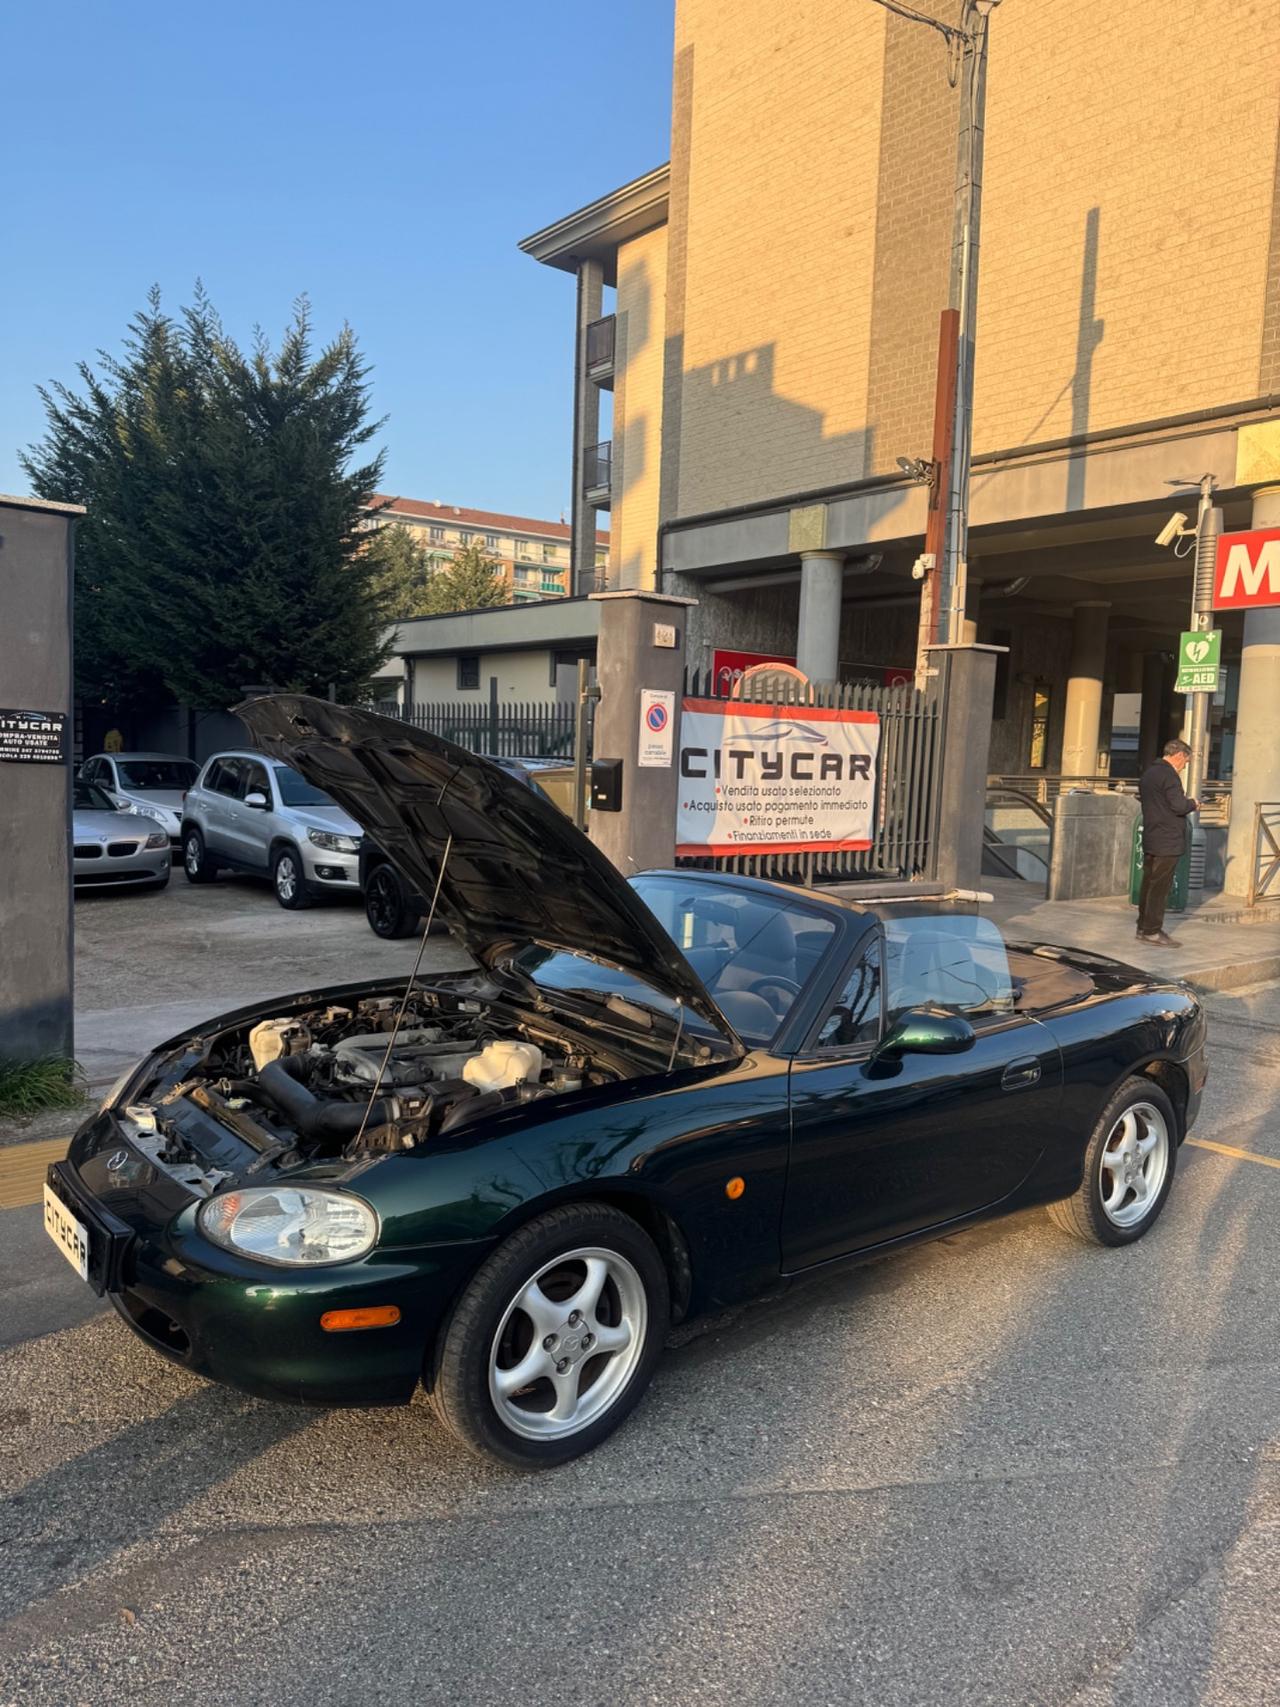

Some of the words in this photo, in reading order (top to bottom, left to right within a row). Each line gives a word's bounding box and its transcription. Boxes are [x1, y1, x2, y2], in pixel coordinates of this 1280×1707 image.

[1219, 540, 1280, 598] M
[1192, 673, 1215, 685] AED
[1, 720, 62, 731] ITYCAR
[0, 733, 58, 741] OMPRA-VENDITA
[680, 747, 871, 781] CITYCAR
[721, 785, 759, 797] Vendita
[761, 786, 788, 797] usato
[789, 785, 841, 797] selezionato
[689, 800, 733, 813] Acquisto
[735, 800, 762, 811] usato
[764, 800, 818, 813] pagamento
[821, 799, 868, 811] immediato
[749, 815, 773, 826] Ritiro
[775, 815, 814, 828] permute
[732, 830, 797, 842] Finanziamenti
[798, 830, 809, 840] in
[809, 830, 832, 840] sede
[46, 1200, 86, 1268] CITYCAR
